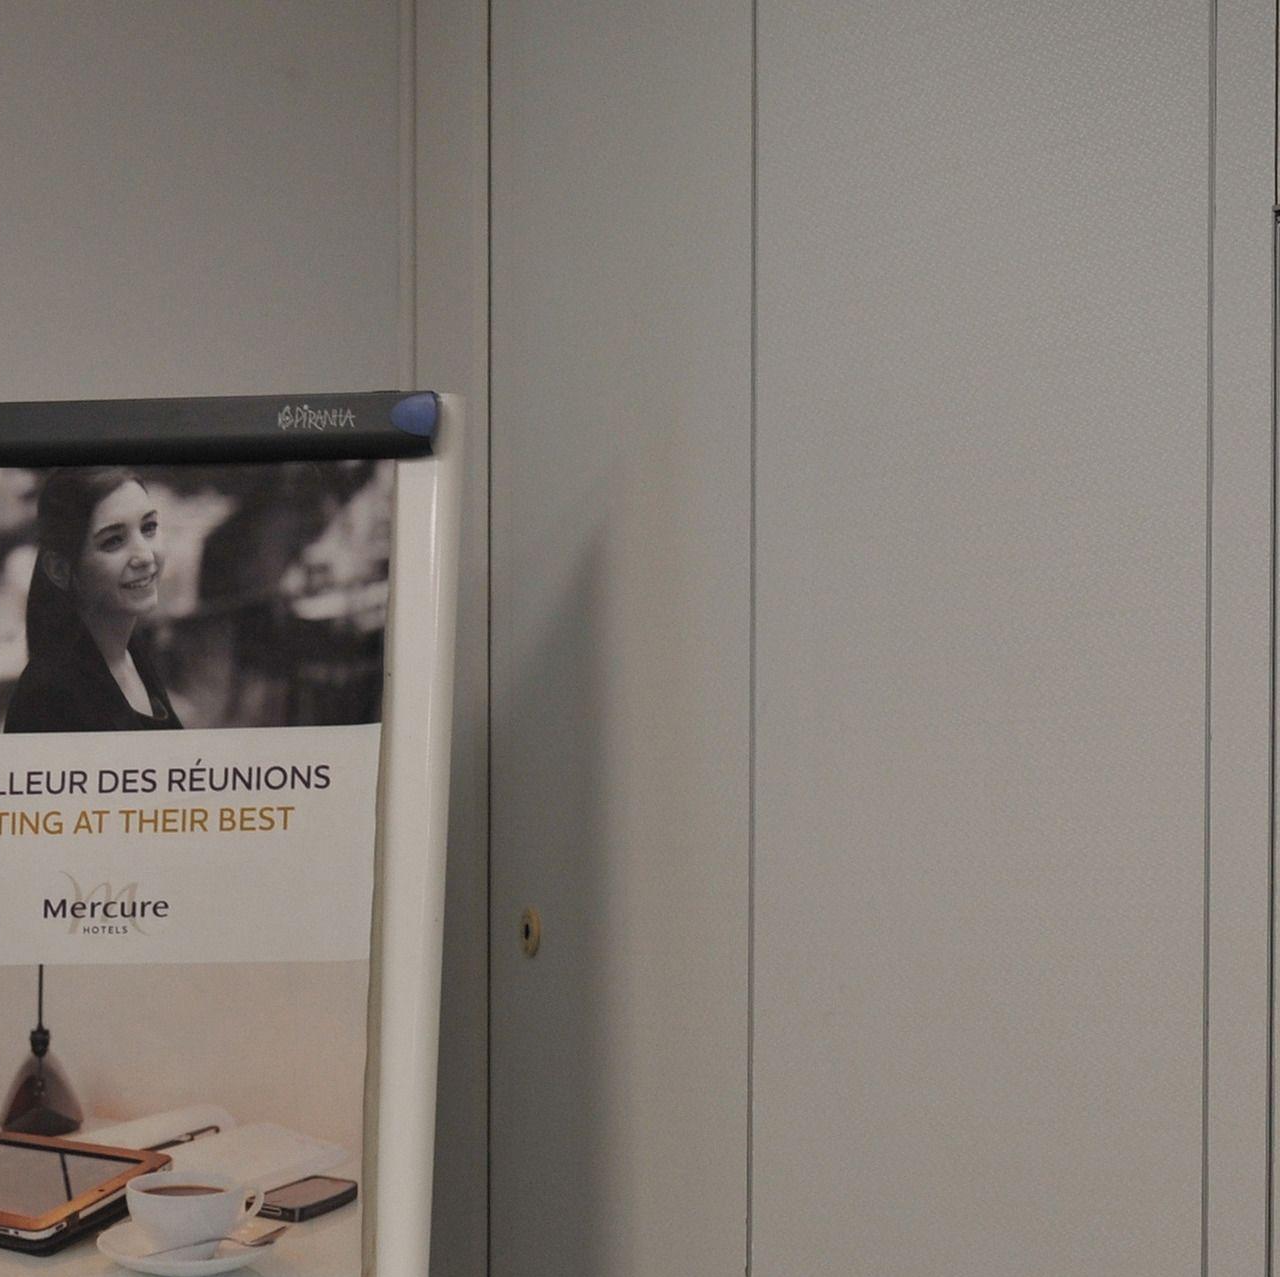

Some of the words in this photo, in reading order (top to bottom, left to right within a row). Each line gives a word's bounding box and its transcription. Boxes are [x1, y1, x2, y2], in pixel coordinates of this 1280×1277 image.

[97, 768, 158, 794] DES
[167, 757, 331, 793] RÉUNIONS
[72, 809, 111, 835] AT
[118, 807, 209, 834] THEIR
[218, 805, 296, 832] BEST
[42, 898, 170, 920] Mercure
[82, 926, 129, 935] HOTELS
